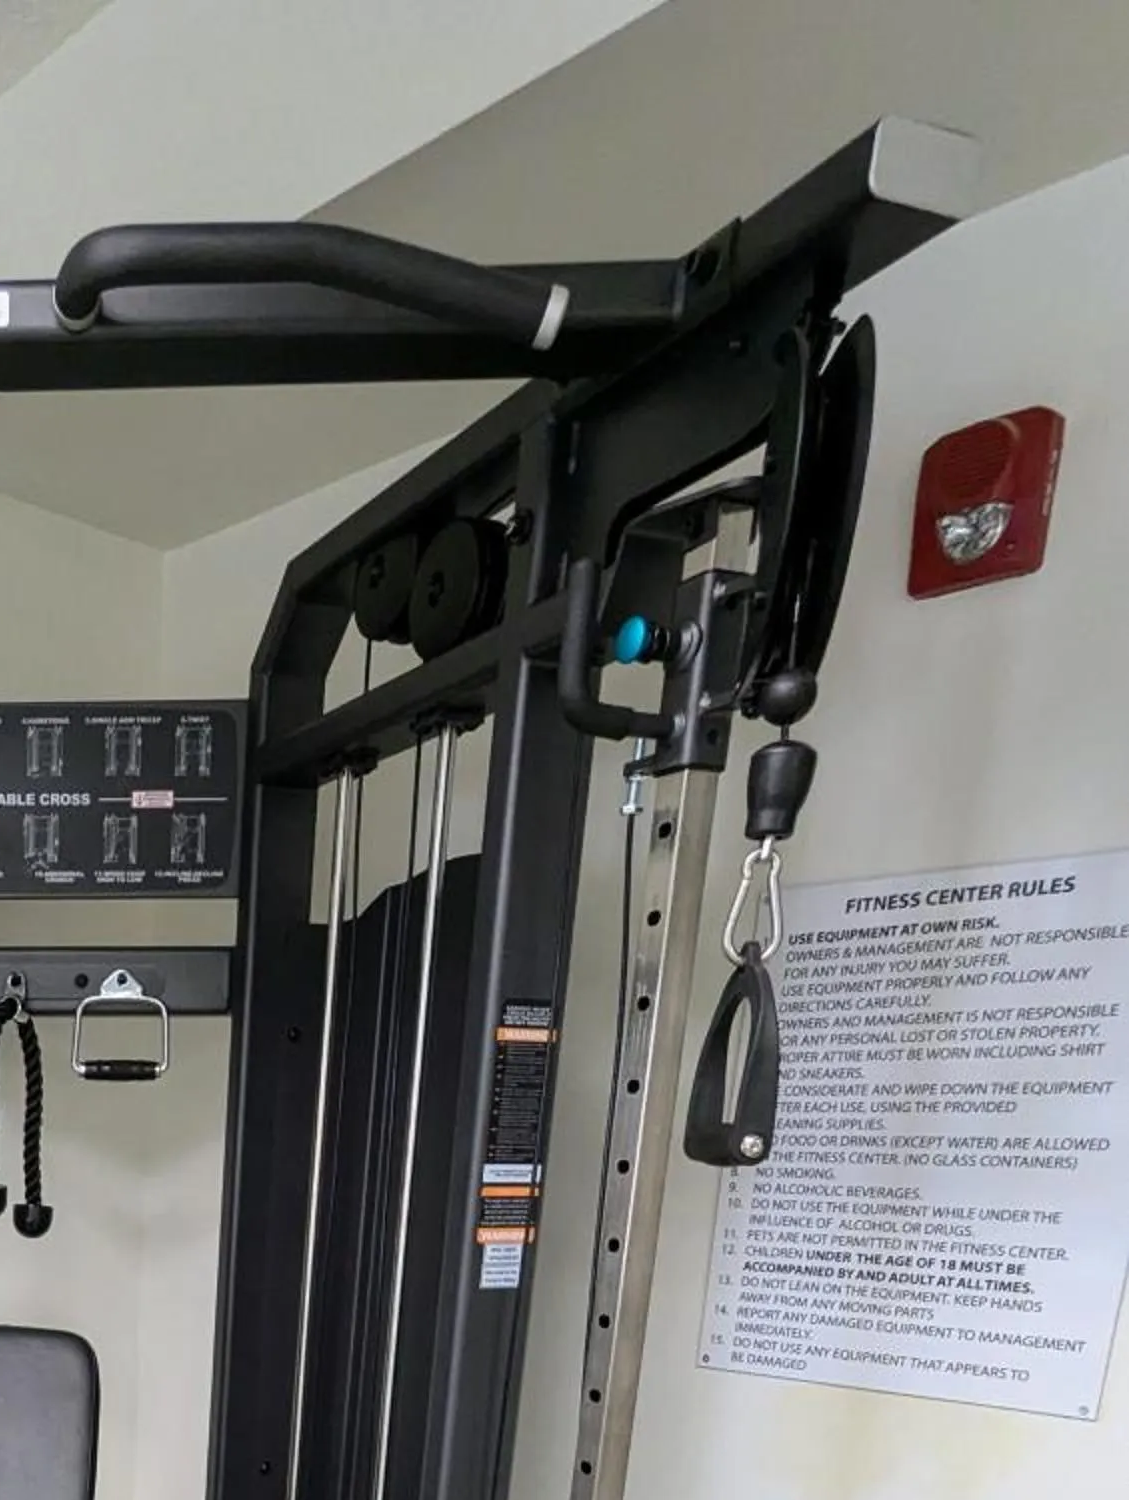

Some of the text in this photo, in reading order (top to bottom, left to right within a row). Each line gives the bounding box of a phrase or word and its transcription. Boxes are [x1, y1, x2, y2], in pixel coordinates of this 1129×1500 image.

[39, 792, 91, 807] CROSS
[845, 875, 1076, 913] FITNESS CENTER RULES
[786, 924, 1129, 962] OWNERS & MANAGEMENT ARE NOT RESPONSIBLE
[788, 916, 1000, 946] USE EQUIPMENT AT OWN RISK.
[783, 966, 808, 980] FOR
[811, 965, 838, 977] ANY
[840, 961, 886, 975] INJURY
[889, 959, 917, 972] YOU
[919, 956, 951, 969] MAY
[781, 966, 1093, 997] USE EQUIPMENT PROPERLY AND FOLLOW ANY
[778, 999, 852, 1013] DIRECTIONS
[833, 1015, 862, 1027] AND
[864, 1010, 963, 1027] MANAGEMENT
[966, 1009, 979, 1022] IS
[982, 1007, 1016, 1021] NOT
[1016, 1003, 1120, 1020] RESPONSIBLE
[800, 1032, 829, 1046] ANY
[830, 1030, 898, 1045] PERSONAL
[900, 1029, 935, 1043] LOST
[936, 1029, 957, 1041] OR
[959, 1026, 1016, 1041] STOLEN
[822, 1049, 863, 1062] ATTIRE
[866, 1047, 904, 1061] MUST
[906, 1046, 924, 1060] BE
[926, 1045, 970, 1059] WORN
[974, 1043, 1056, 1059] INCLUDING
[1059, 1042, 1107, 1057] SHIRT
[784, 1084, 868, 1097] CONSIDERATE
[871, 1083, 902, 1096] AND
[904, 1083, 939, 1096] WIPE
[941, 1082, 988, 1095] DOWN
[991, 1081, 1020, 1095] THE
[1022, 1081, 1113, 1096] EQUIPMENT
[804, 1101, 837, 1113] EACH
[870, 1101, 912, 1113] USING
[914, 1101, 940, 1113] THE
[943, 1100, 1018, 1114] PROVIDED
[781, 1134, 817, 1147] FOOD
[819, 1134, 838, 1147] OR
[840, 1135, 887, 1148] DRINKS
[1001, 1137, 1031, 1150] ARE
[1032, 1137, 1112, 1151] ALLOWED
[773, 1150, 793, 1162] THE
[796, 1150, 846, 1164] FITNESS
[932, 1153, 976, 1168] GLASS
[755, 1166, 774, 1178] NO
[752, 1182, 772, 1194] NO
[774, 1183, 844, 1197] ALCOHOLIC
[750, 1198, 770, 1209] DO
[772, 1199, 798, 1211] NOT
[800, 1200, 825, 1213] USE
[826, 1201, 851, 1214] THE
[852, 1202, 928, 1218] EQUIPMENT
[931, 1206, 976, 1221] WHILE
[977, 1208, 1030, 1223] UNDER
[1031, 1211, 1064, 1225] THE
[748, 1214, 814, 1228] INFLUENCE
[816, 1216, 835, 1228] OF
[838, 1218, 899, 1234] ALCOHOL
[902, 1222, 922, 1235] OR
[746, 1229, 773, 1242] PETS
[776, 1231, 801, 1243] ARE
[802, 1232, 828, 1245] NOT
[830, 1234, 903, 1251] PERMITTED
[904, 1239, 919, 1251] IN
[921, 1240, 949, 1254] THE
[950, 1242, 1007, 1258] FITNESS
[744, 1245, 803, 1260] CHILDREN
[805, 1249, 853, 1264] UNDER
[856, 1252, 883, 1266] THE
[884, 1254, 914, 1268] AGE
[916, 1256, 937, 1269] OF
[940, 1258, 957, 1271] 18
[958, 1259, 1004, 1275] MUST
[1006, 1262, 1027, 1276] BE
[742, 1260, 1037, 1296] ACCOMPANIED BY AND ADULT AT ALL TIMES.
[739, 1290, 935, 1321] AWAY FROM ANY MOVING PARTS
[741, 1275, 760, 1287] DO
[761, 1276, 787, 1290] NOT
[788, 1280, 820, 1293] LEAN
[822, 1282, 844, 1295] ON
[845, 1284, 869, 1298] THE
[954, 1293, 990, 1308] KEEP
[991, 1297, 1044, 1313] HANDS
[736, 1306, 782, 1320] REPORT
[782, 1310, 809, 1324] ANY
[810, 1313, 875, 1331] DAMAGED
[876, 1320, 954, 1340] EQUIPMENT
[957, 1328, 976, 1341] TO
[978, 1330, 1087, 1353] MANAGEMENT
[730, 1350, 807, 1370] BE DAMAGED
[733, 1335, 752, 1348] DO
[753, 1338, 781, 1352] NOT
[781, 1341, 803, 1355] USE
[805, 1344, 832, 1358] ANY
[834, 1347, 908, 1366] EQUIPMENT
[910, 1356, 944, 1371] THAT
[944, 1359, 1008, 1379] APPEARS
[1010, 1368, 1030, 1382] TO
